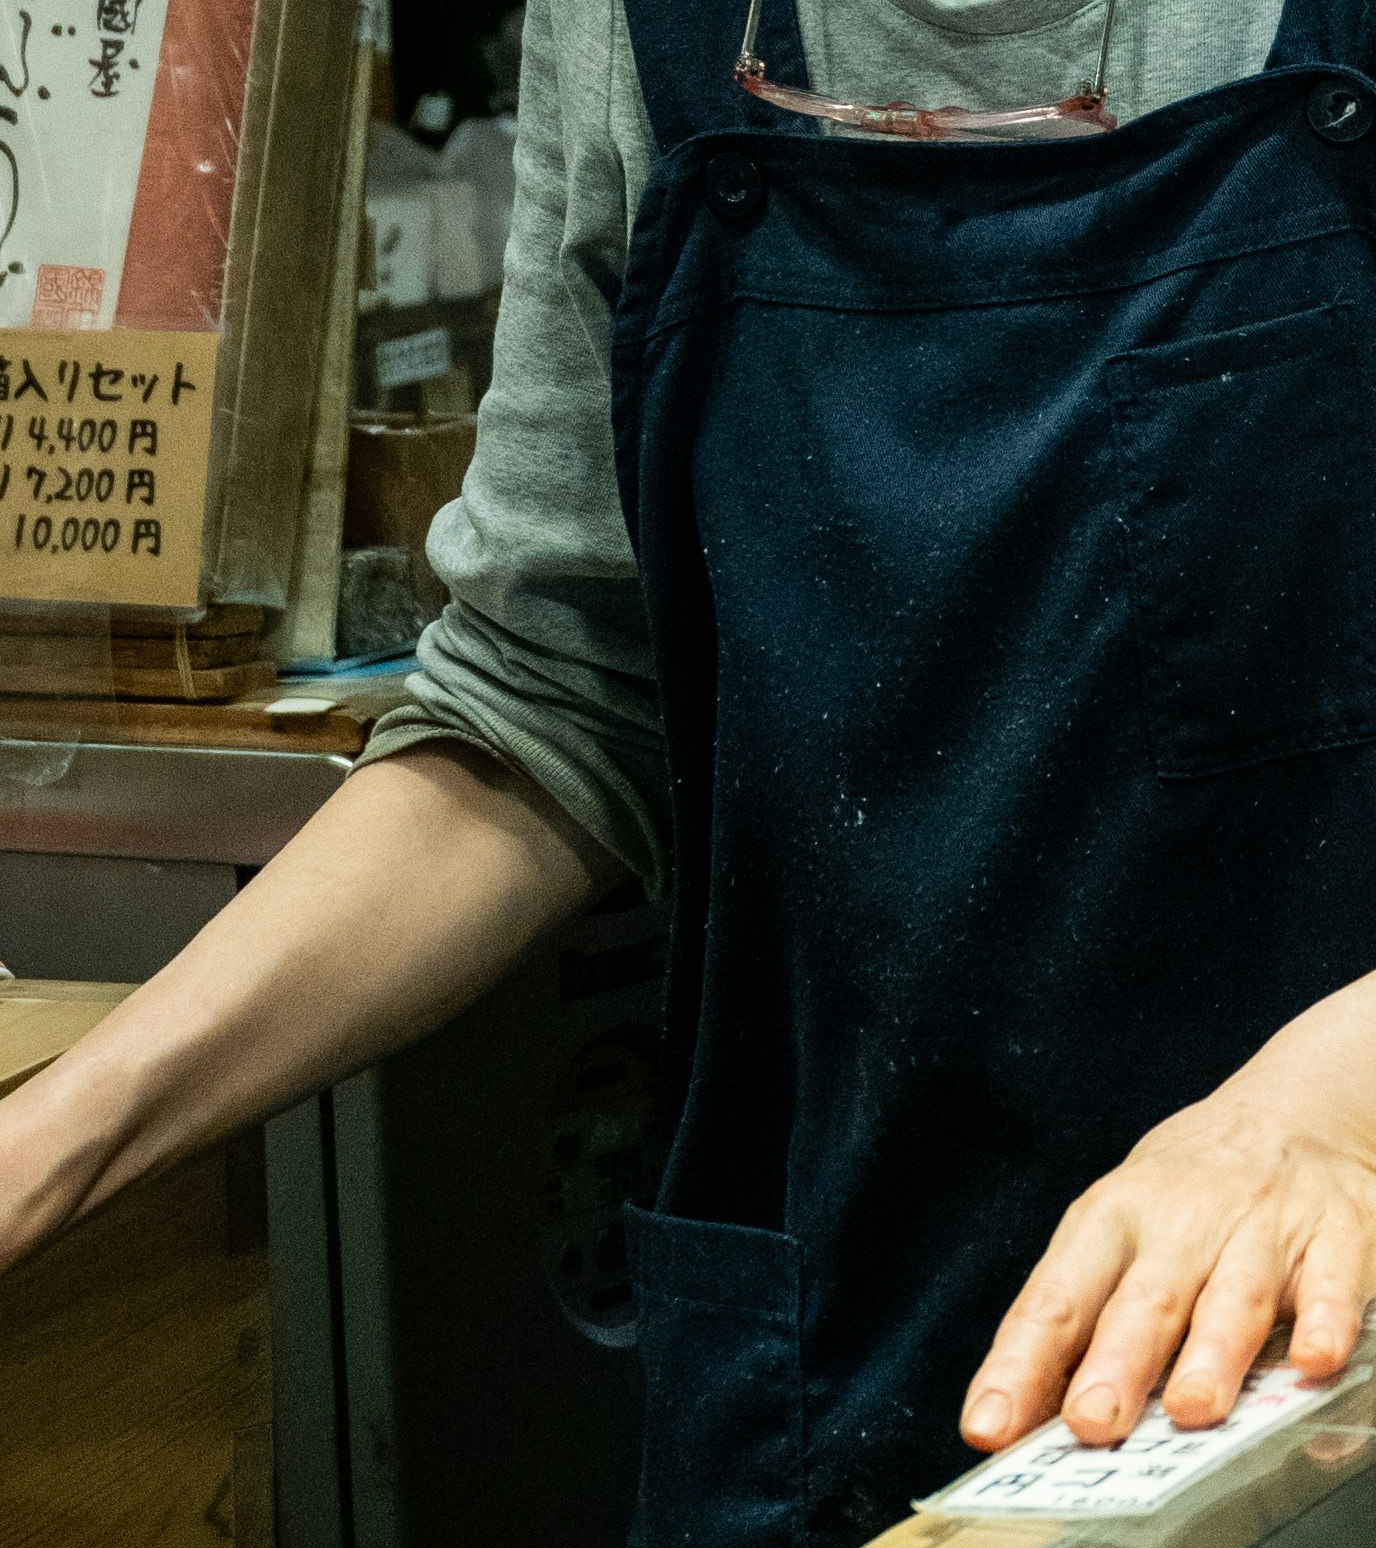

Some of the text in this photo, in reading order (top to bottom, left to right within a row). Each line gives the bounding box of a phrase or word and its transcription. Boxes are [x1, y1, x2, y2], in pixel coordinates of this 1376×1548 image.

[28, 417, 159, 455] 4,400円
[26, 467, 155, 504] 7,200円
[15, 514, 162, 556] 10,000円
